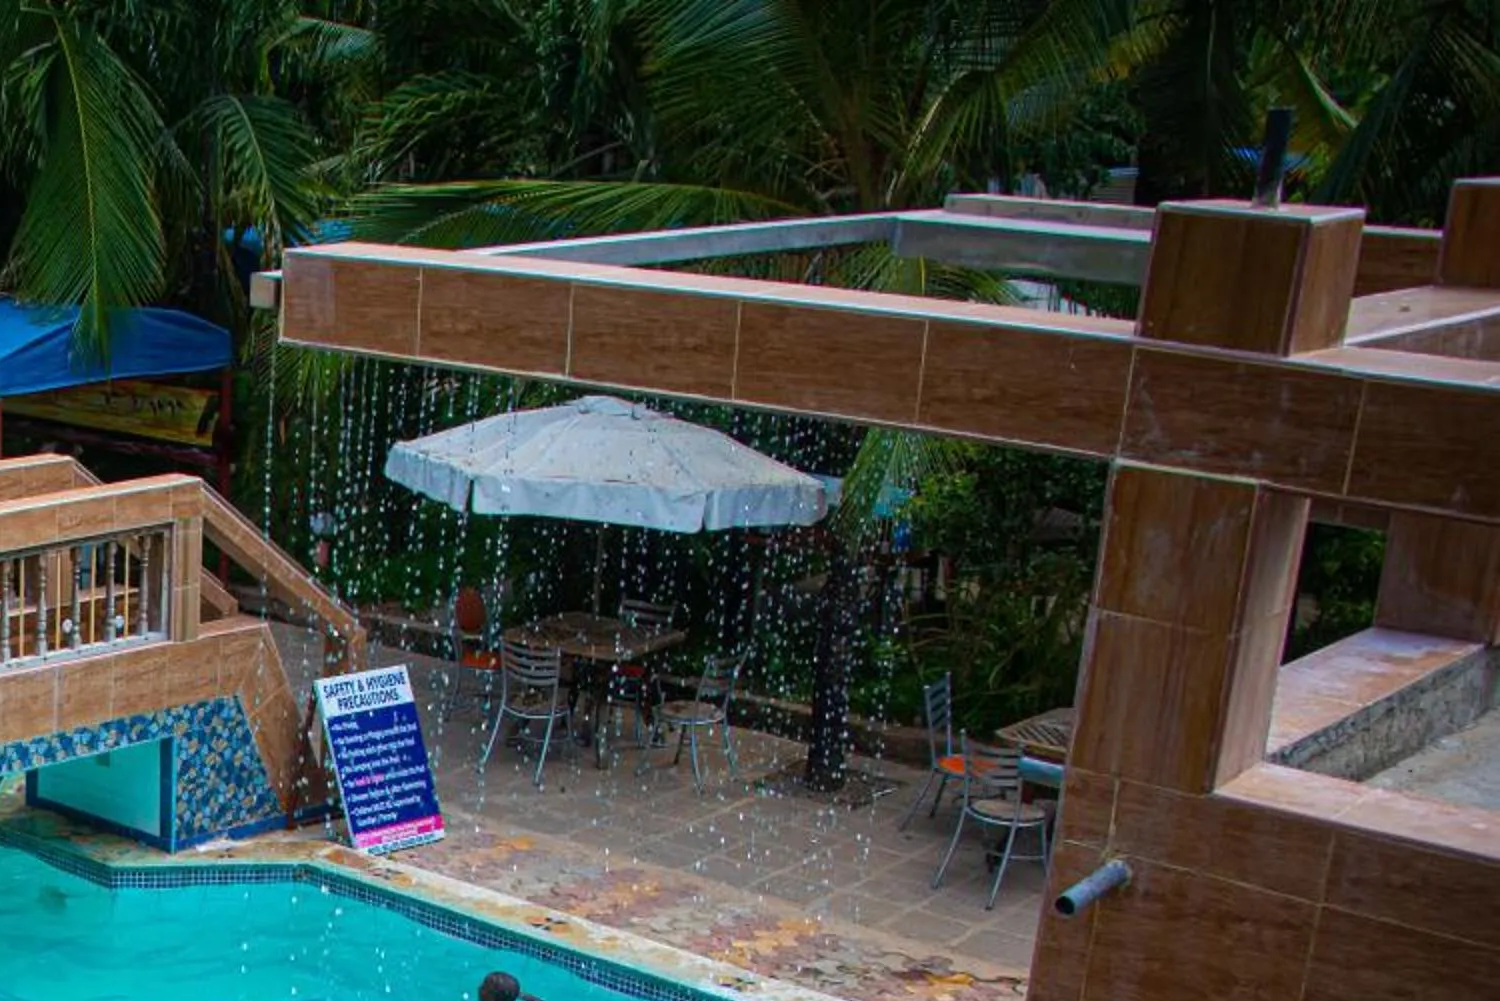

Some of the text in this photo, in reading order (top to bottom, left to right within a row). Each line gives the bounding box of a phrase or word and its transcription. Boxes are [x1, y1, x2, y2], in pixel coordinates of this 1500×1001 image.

[323, 680, 355, 699] SAFETY
[366, 671, 407, 693] HYGIENE
[338, 687, 399, 711] PRECAUTIONS
